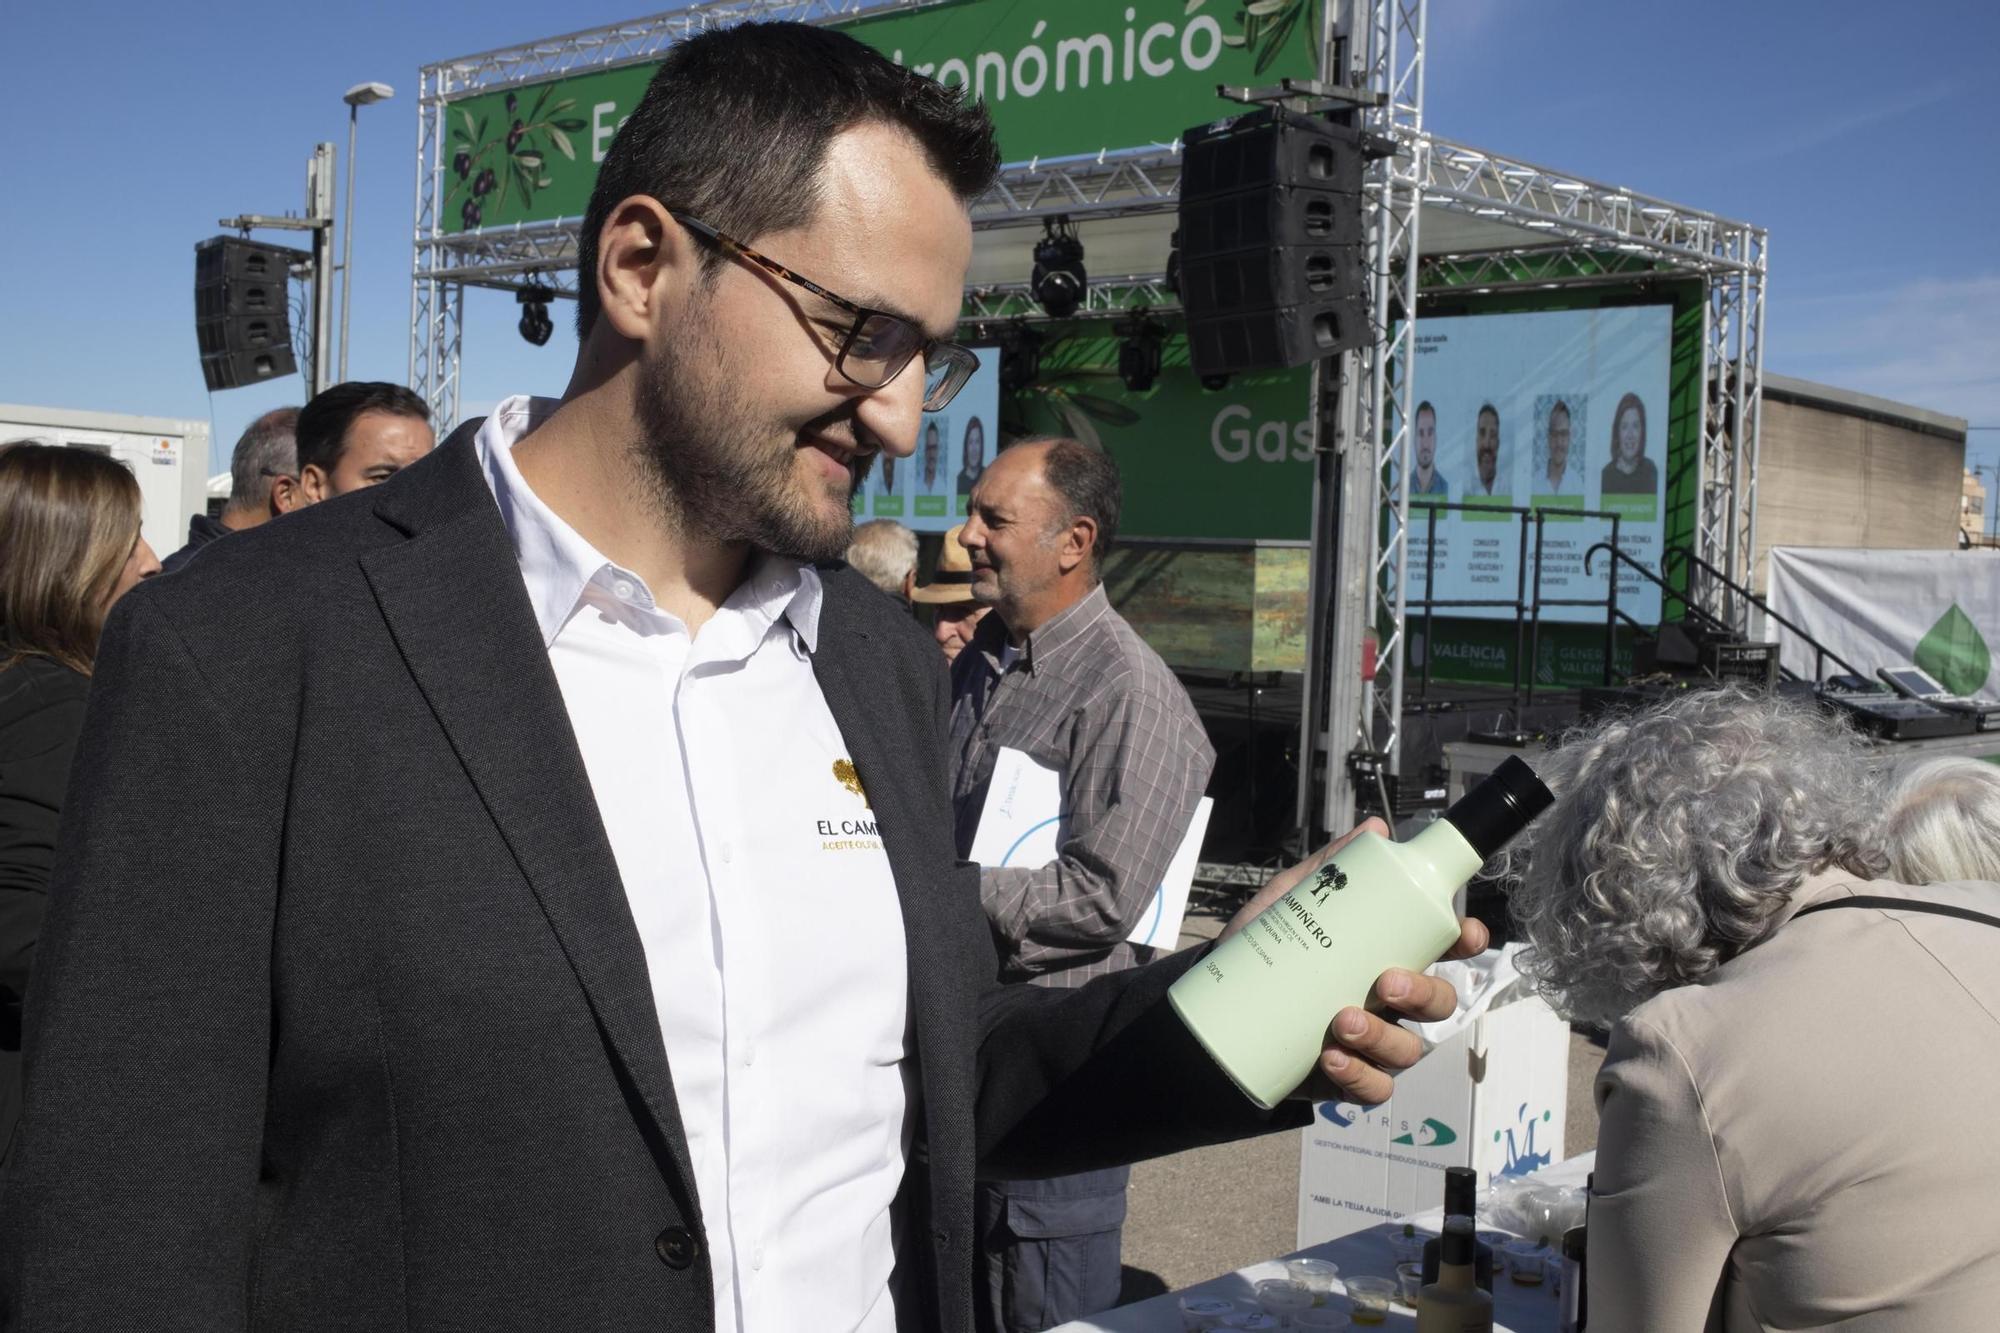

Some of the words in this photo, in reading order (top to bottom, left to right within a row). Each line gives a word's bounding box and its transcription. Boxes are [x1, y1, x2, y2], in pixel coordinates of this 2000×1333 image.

[592, 101, 630, 162] E
[1433, 643, 1506, 661] VALÈNCIA
[817, 820, 839, 835] EL
[841, 820, 881, 836] CAM
[1332, 1199, 1342, 1207] LA
[1366, 1206, 1392, 1217] AJUDA
